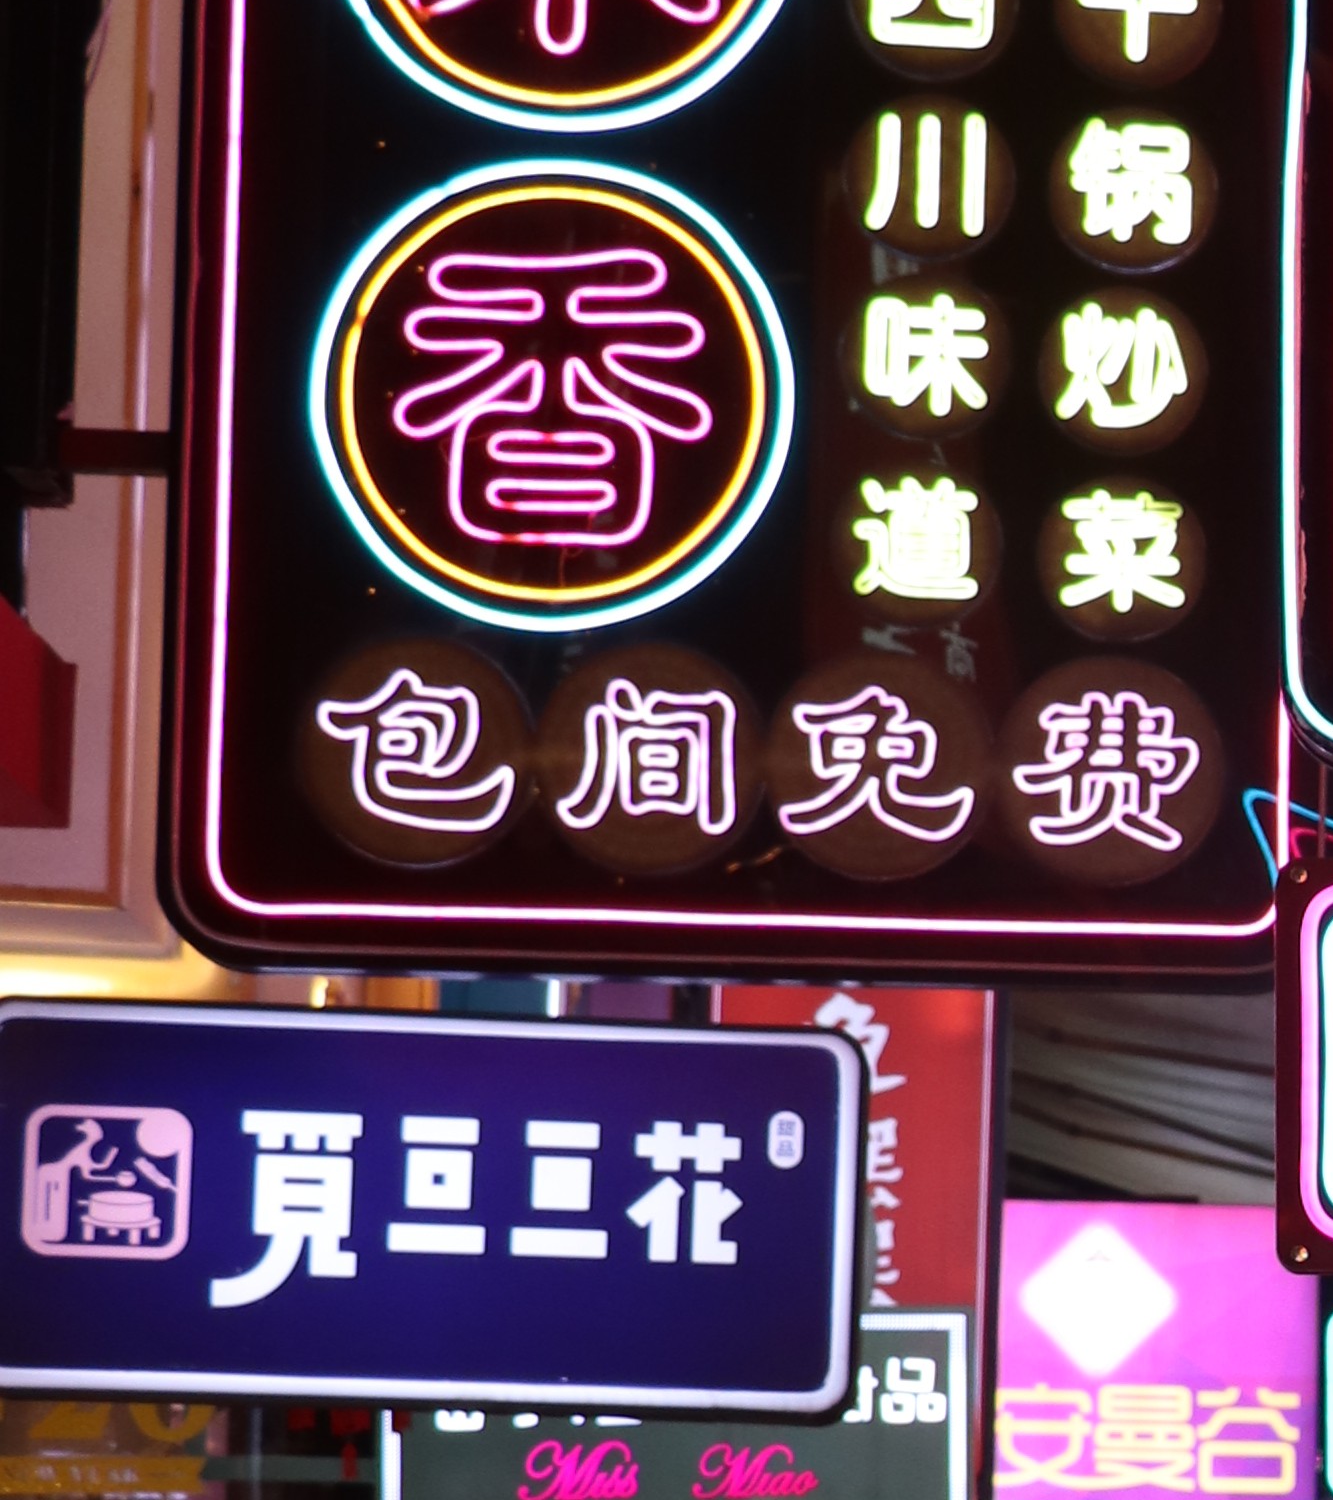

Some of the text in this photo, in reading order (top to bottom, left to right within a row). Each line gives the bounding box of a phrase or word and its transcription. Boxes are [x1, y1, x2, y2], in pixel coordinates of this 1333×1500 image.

[316, 666, 1203, 854] 包间免费
[691, 1443, 819, 1500] Miao
[993, 1382, 1301, 1495] 安曼谷
